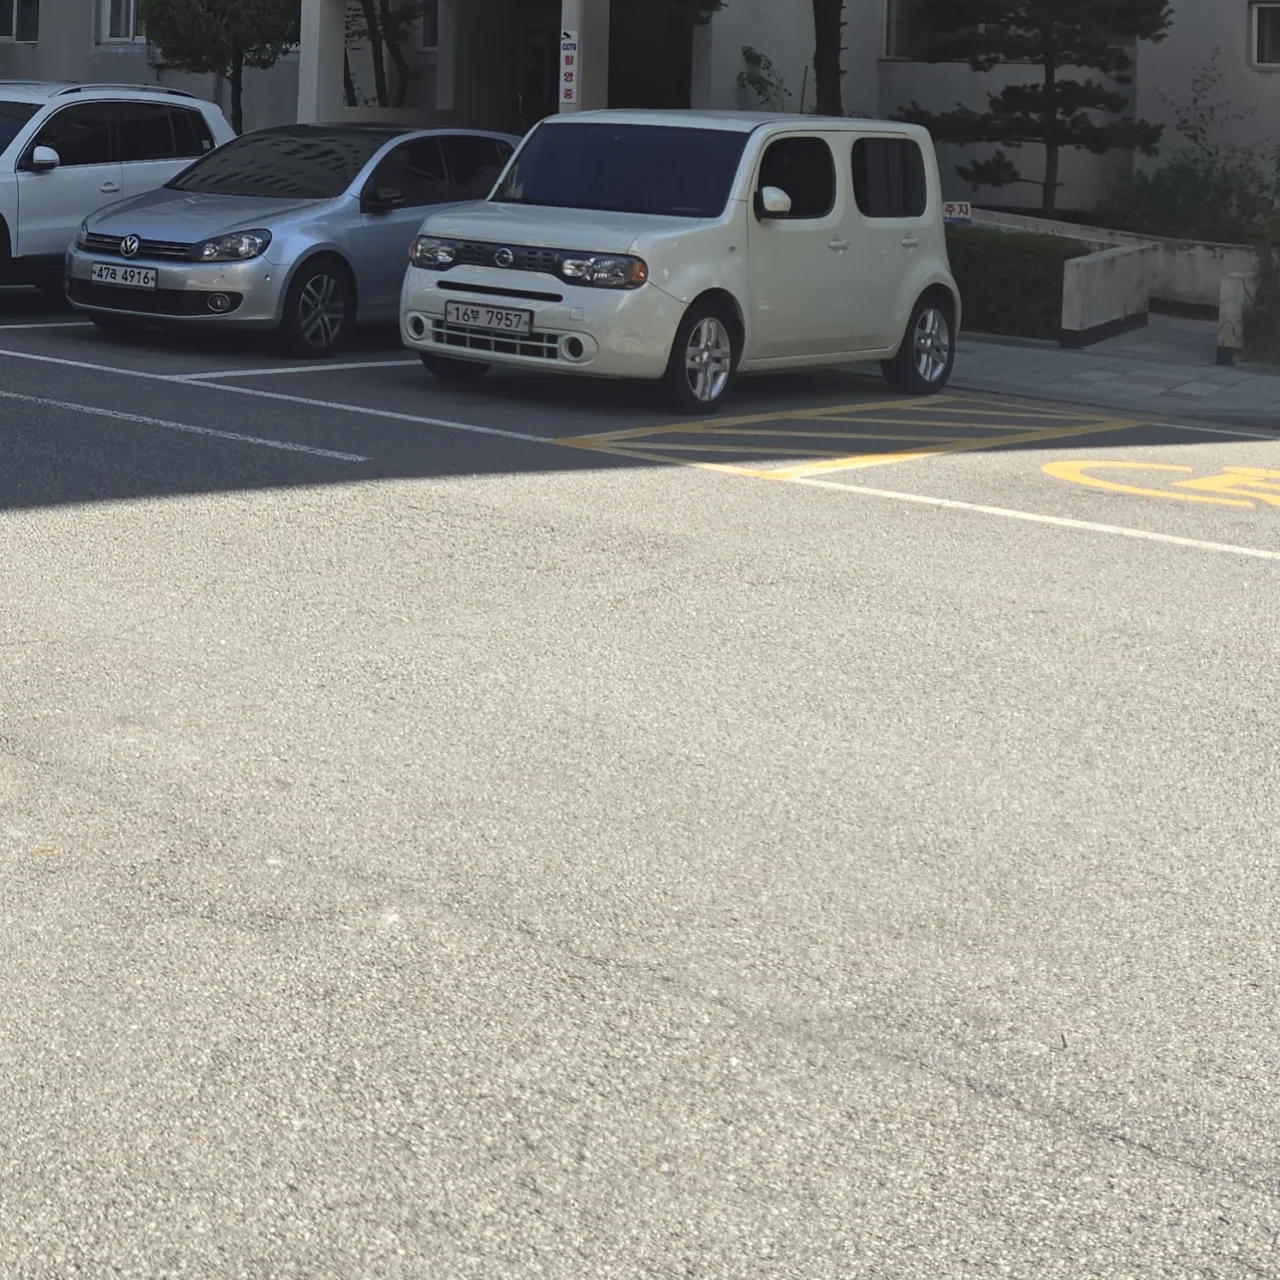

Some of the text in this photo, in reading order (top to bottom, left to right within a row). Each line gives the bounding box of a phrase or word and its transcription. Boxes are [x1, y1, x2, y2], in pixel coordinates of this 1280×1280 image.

[121, 268, 150, 285] 4916
[454, 306, 522, 329] 16부 7957
